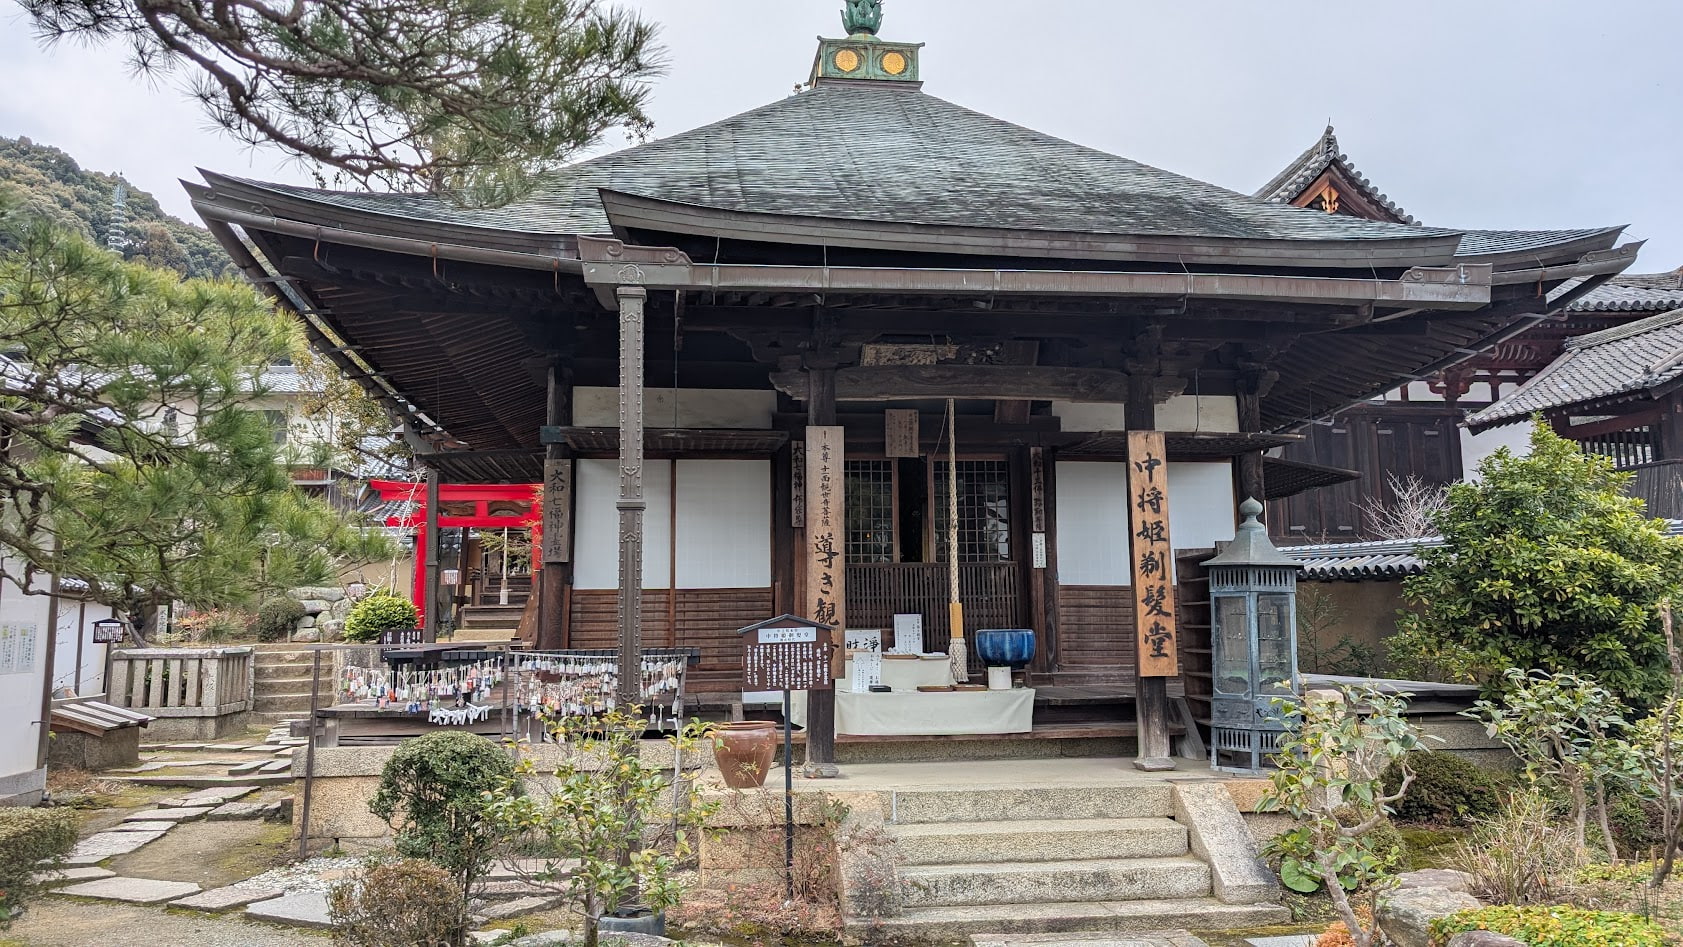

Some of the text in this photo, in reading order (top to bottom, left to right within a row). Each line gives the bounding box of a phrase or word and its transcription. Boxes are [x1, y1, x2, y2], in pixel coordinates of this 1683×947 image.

[814, 531, 840, 661] 導き観
[1134, 451, 1173, 659] 中将姫剃髪堂
